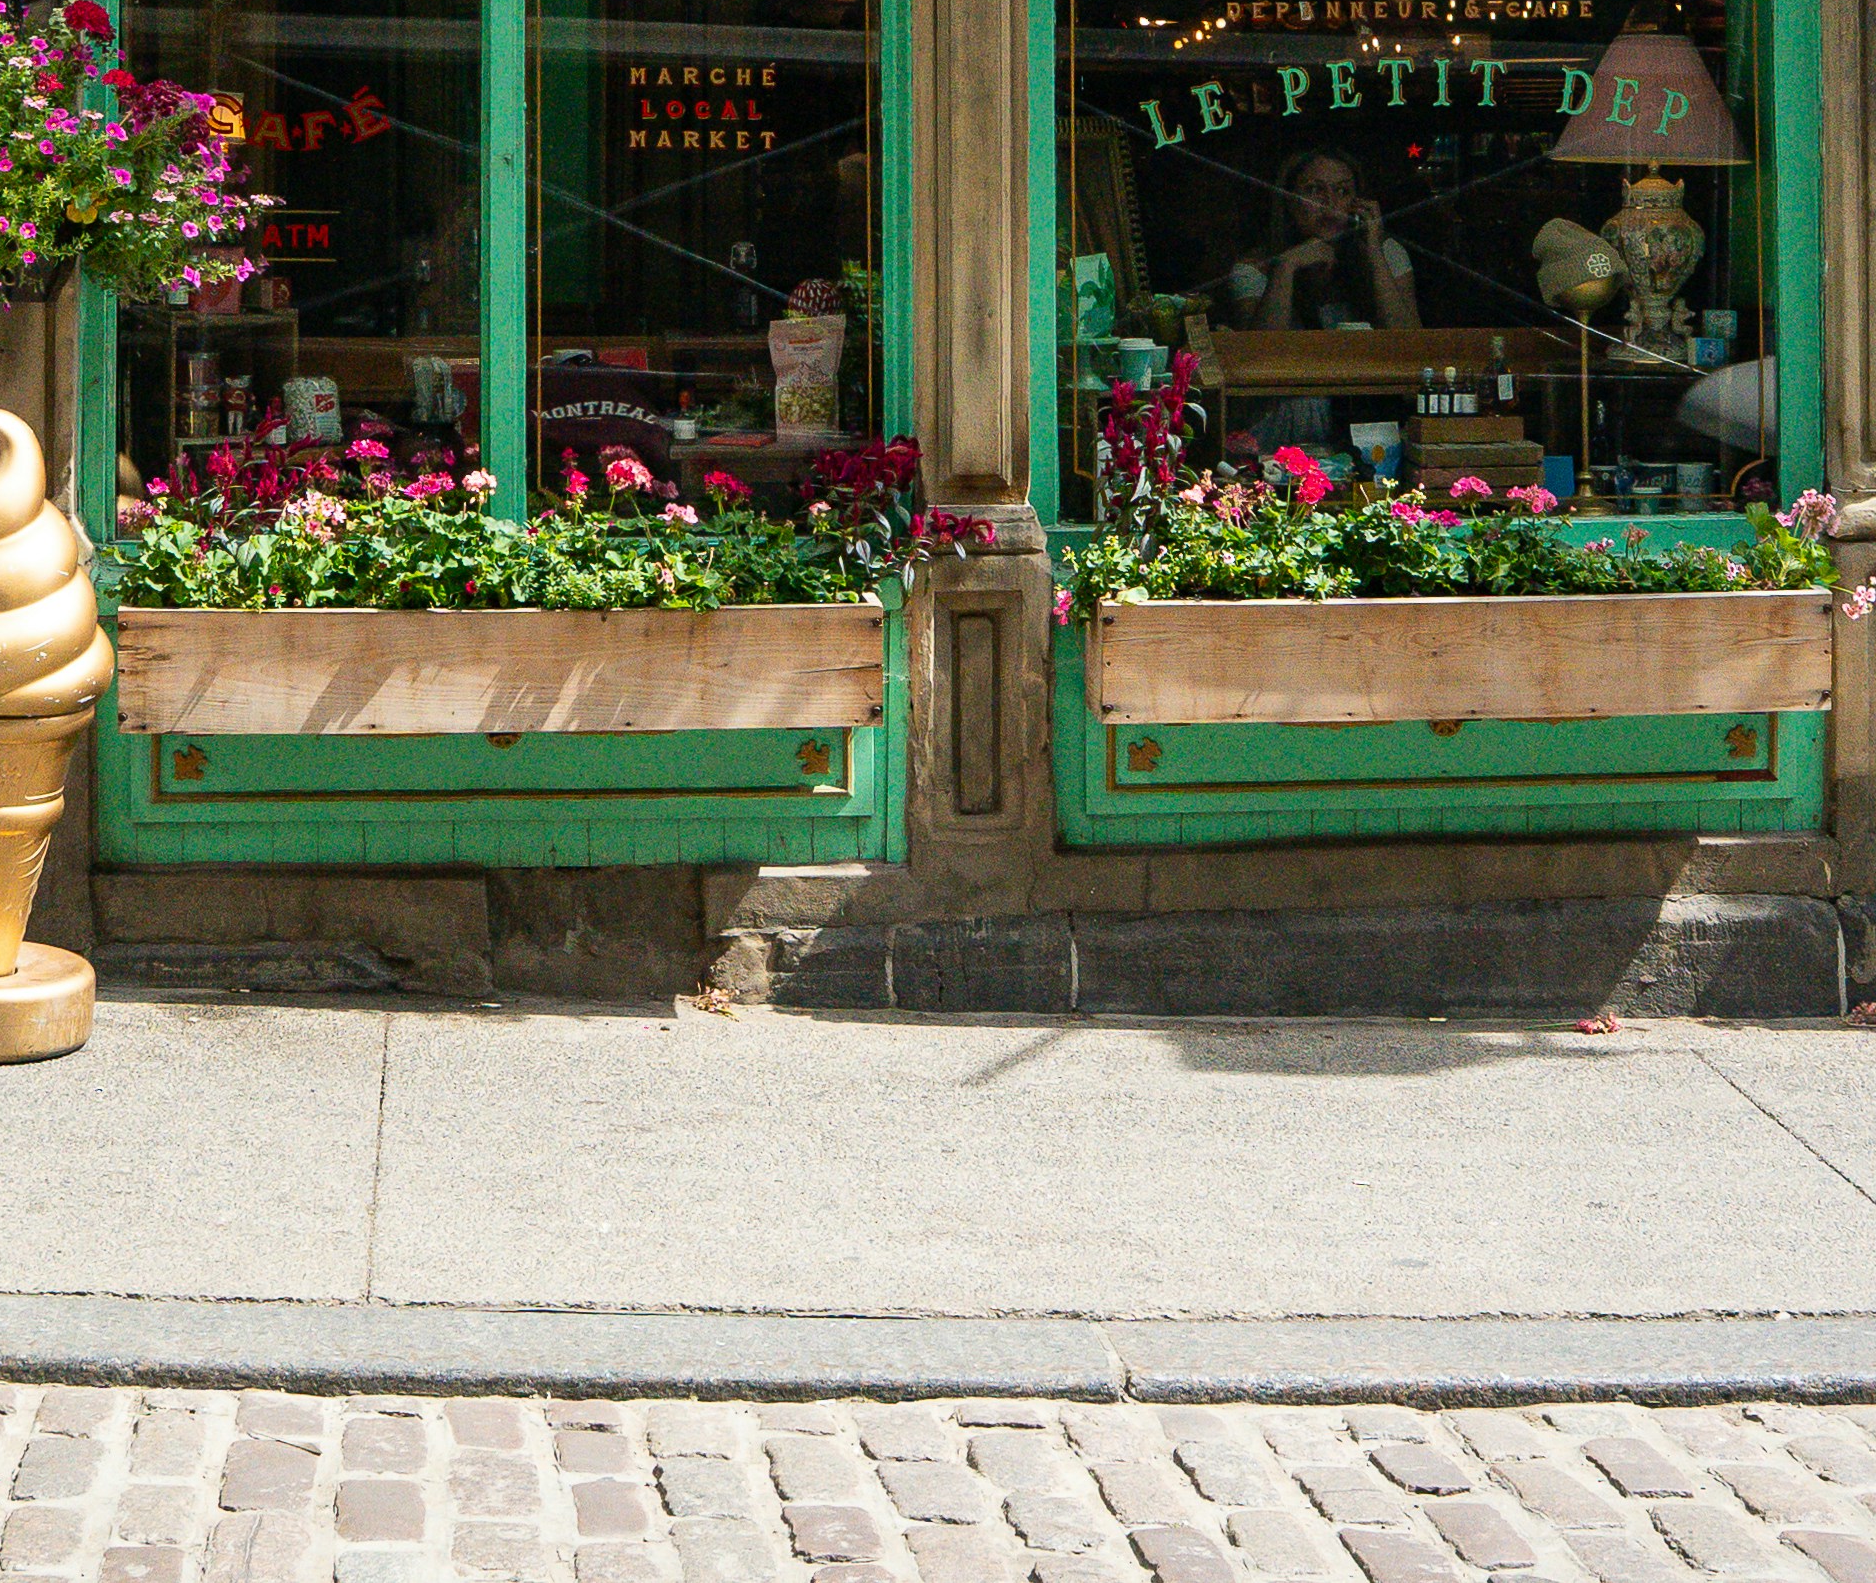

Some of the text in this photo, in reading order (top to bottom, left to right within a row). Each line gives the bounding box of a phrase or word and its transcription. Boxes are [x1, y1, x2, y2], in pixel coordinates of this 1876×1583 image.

[629, 61, 777, 86] MARCHÉ
[640, 99, 763, 121] LOCAL
[1140, 58, 1691, 150] LE PETIT DEP
[628, 130, 777, 150] MARKET
[261, 224, 330, 249] ATM
[530, 400, 659, 425] MONTREAL
